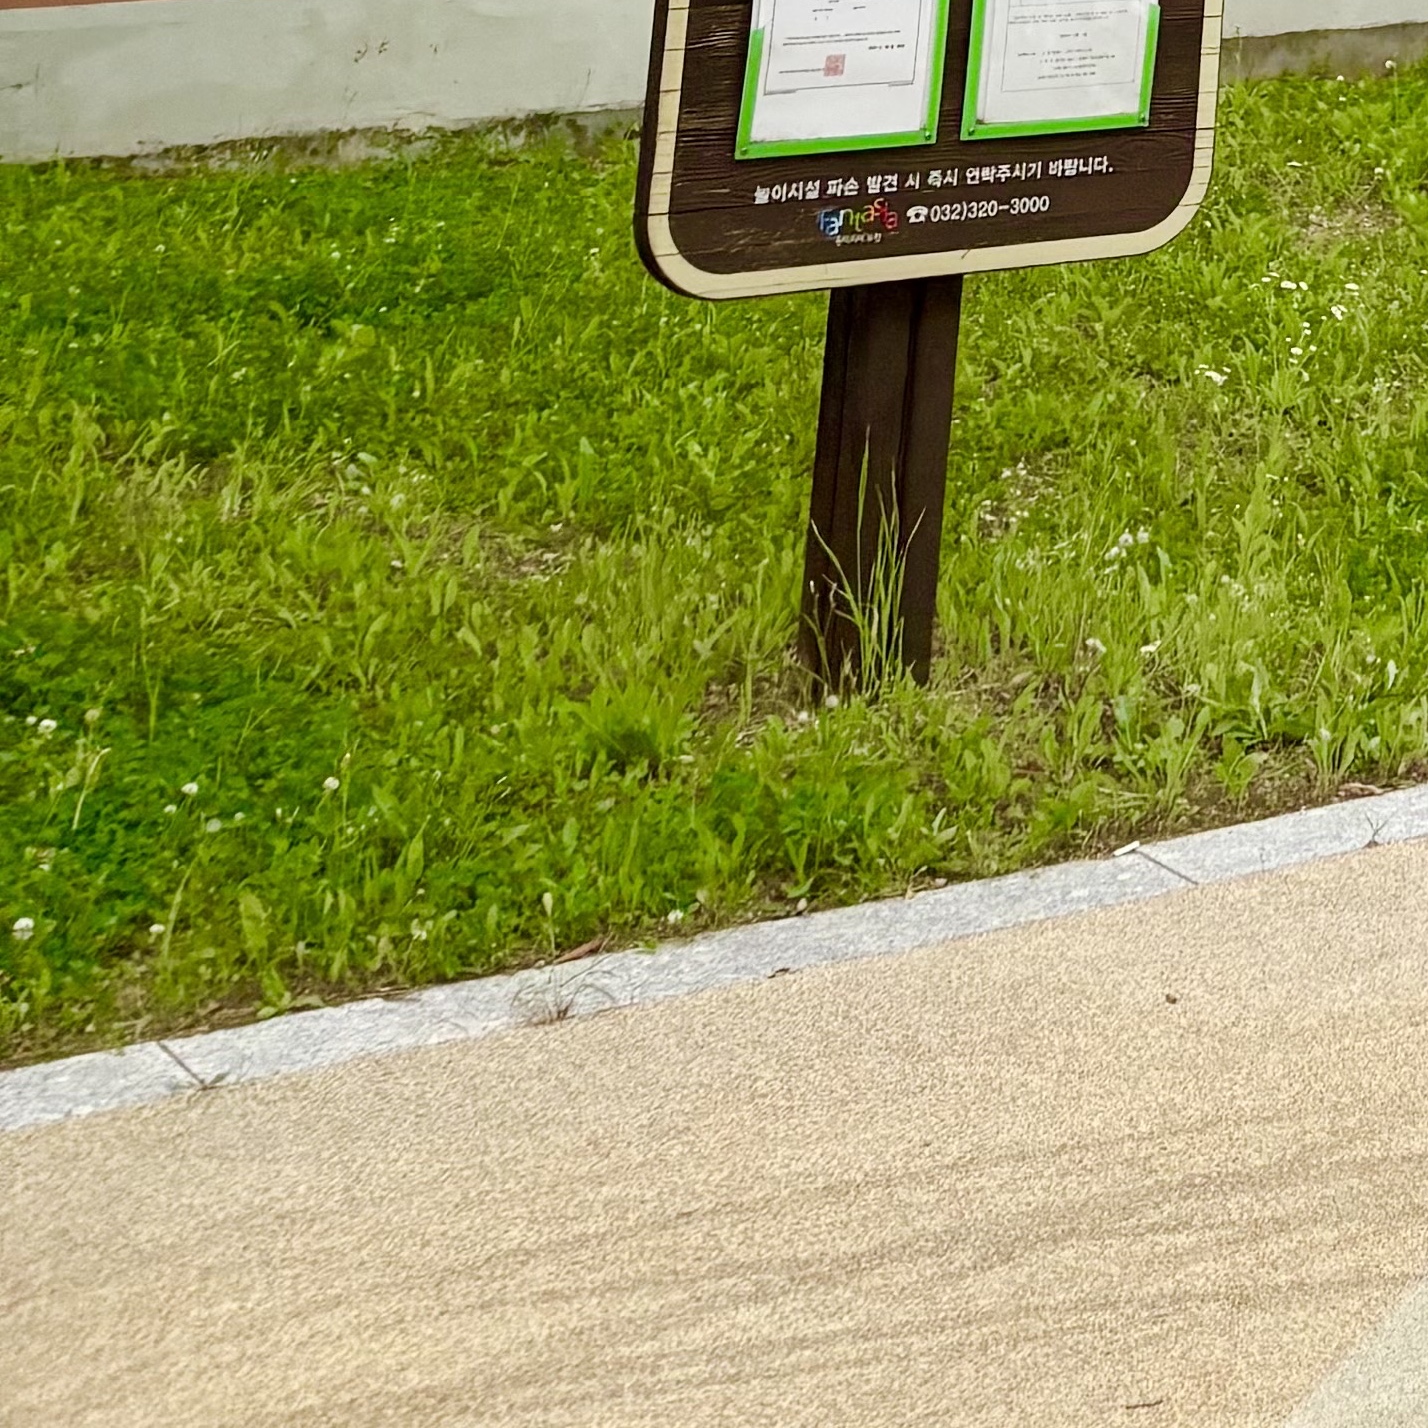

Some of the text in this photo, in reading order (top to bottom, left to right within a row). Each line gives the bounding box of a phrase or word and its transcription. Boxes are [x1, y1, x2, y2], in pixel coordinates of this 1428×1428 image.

[754, 155, 1114, 205] 놀이시설 파손 발견 시 즉시 연락주시기 바랍니다.
[930, 195, 1051, 223] 032)320-3000
